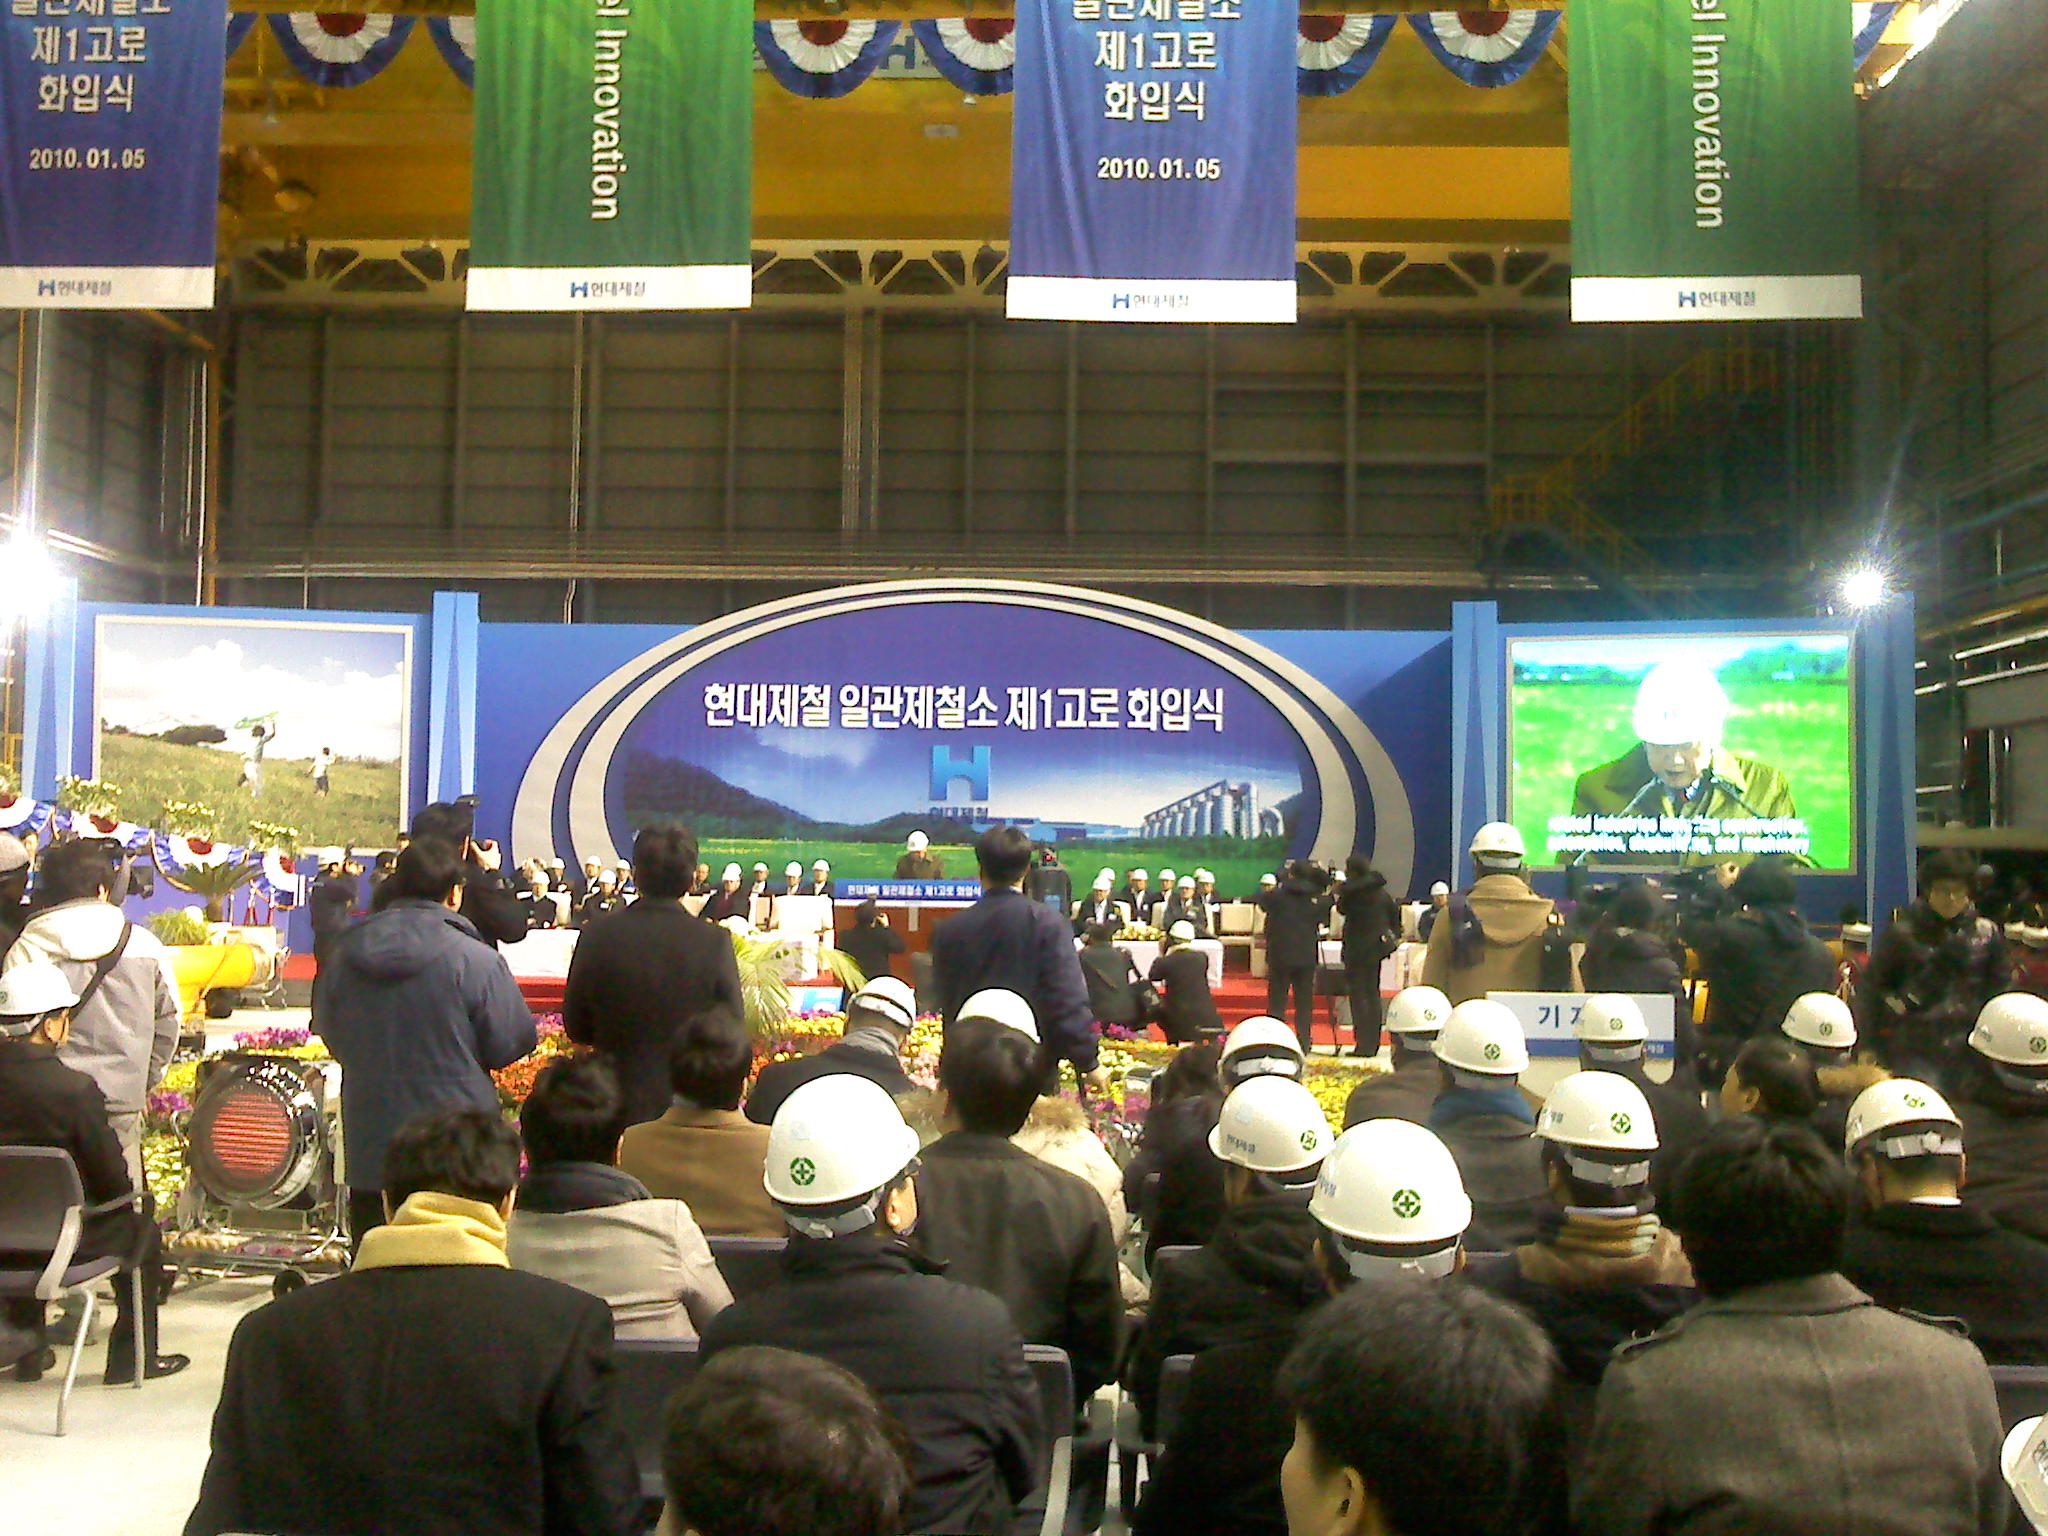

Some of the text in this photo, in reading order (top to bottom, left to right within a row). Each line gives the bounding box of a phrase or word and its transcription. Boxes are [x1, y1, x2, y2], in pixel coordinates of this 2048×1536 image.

[30, 26, 146, 64] 제1고로
[1094, 30, 1217, 70] 제1고로
[38, 73, 135, 112] 화입식
[1103, 80, 1205, 121] 화입식
[591, 29, 628, 219] Innovation
[1691, 34, 1730, 228] Innovation
[29, 148, 146, 170] 2010.01.05
[1097, 157, 1221, 180] 2010.01.05
[703, 682, 1224, 733] 현대제철 일관제철소 제1고로 화입식
